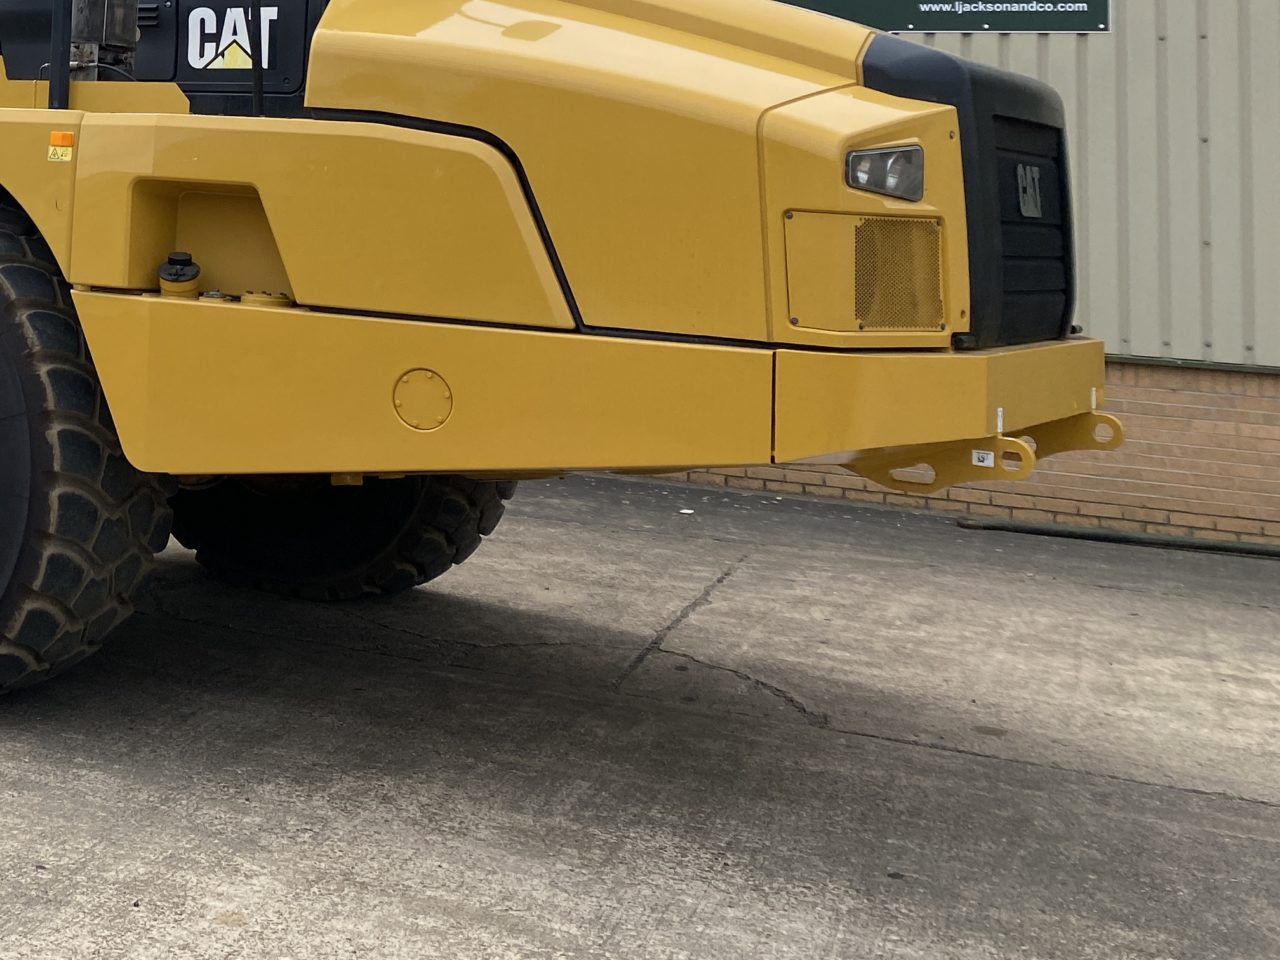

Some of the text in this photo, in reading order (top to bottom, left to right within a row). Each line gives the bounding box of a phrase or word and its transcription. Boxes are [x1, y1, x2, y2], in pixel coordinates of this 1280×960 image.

[919, 0, 1088, 14] www.ljacksonandco.com
[187, 6, 278, 69] CAT
[1017, 163, 1043, 218] CAT
